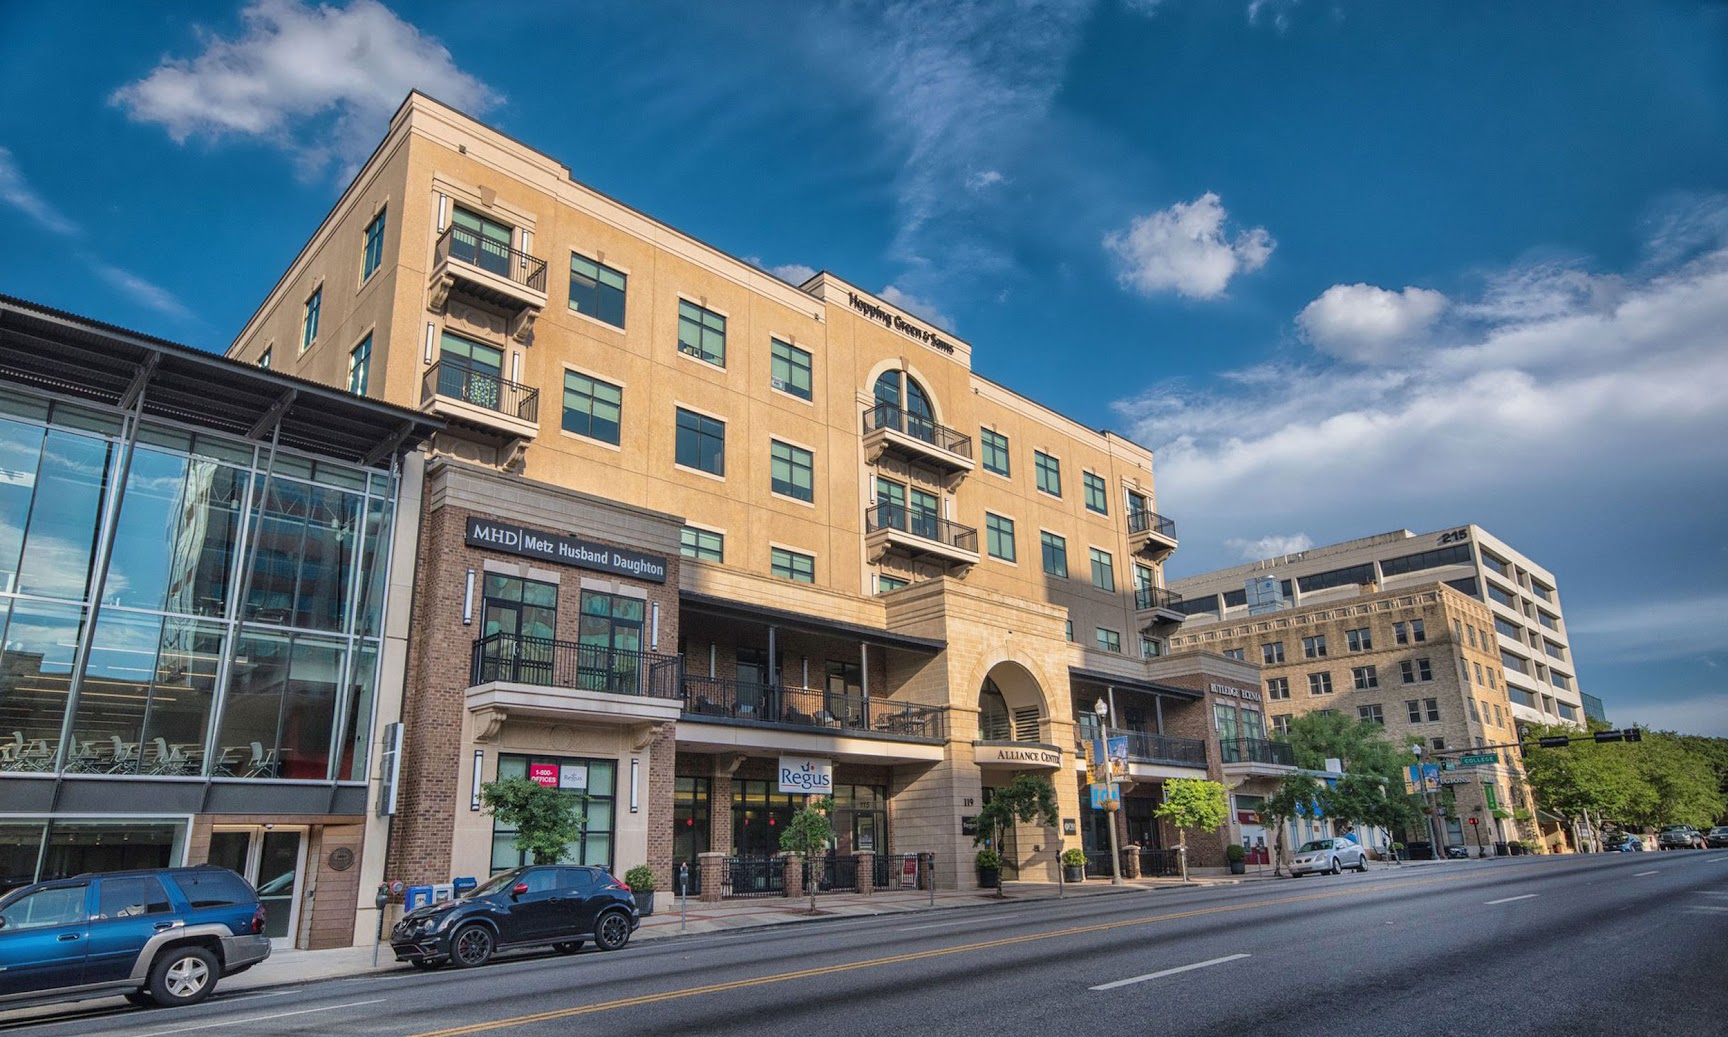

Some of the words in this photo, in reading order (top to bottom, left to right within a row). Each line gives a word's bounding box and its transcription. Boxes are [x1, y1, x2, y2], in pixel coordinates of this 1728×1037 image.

[848, 292, 892, 328] Hopping
[894, 315, 922, 340] Green
[922, 331, 931, 343] &
[1441, 529, 1467, 543] 215
[473, 524, 518, 546] MHD
[524, 535, 554, 554] Metz
[558, 542, 608, 565] Husband
[613, 553, 664, 576] Daughton
[1210, 683, 1240, 697] RUTLEDGE
[997, 749, 1039, 761] ALLIANCE
[781, 768, 830, 789] Regus
[1440, 777, 1472, 785] EGIONS
[963, 797, 974, 807] 119
